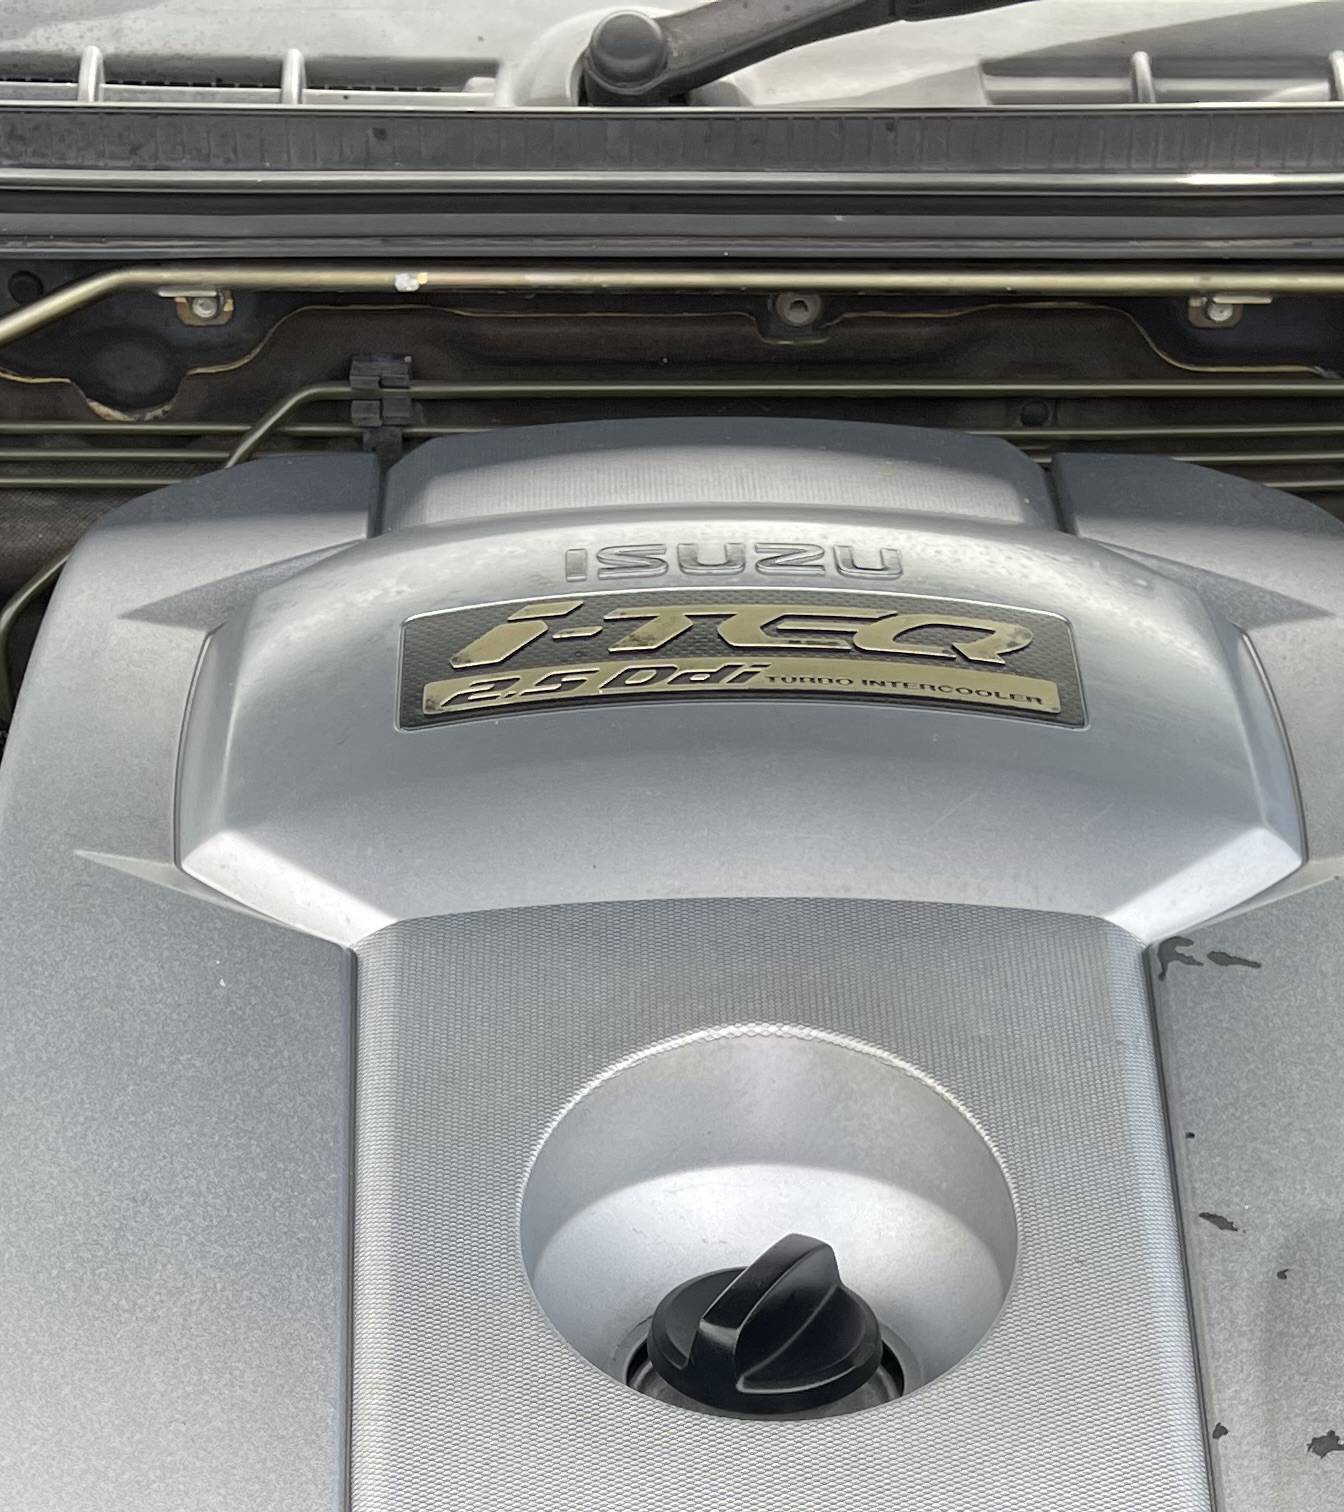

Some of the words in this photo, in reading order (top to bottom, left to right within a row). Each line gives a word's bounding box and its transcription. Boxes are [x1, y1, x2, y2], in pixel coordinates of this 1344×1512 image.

[564, 542, 904, 582] ISUZU
[765, 675, 854, 686] TURBO
[862, 679, 1044, 705] INTERCOOLER
